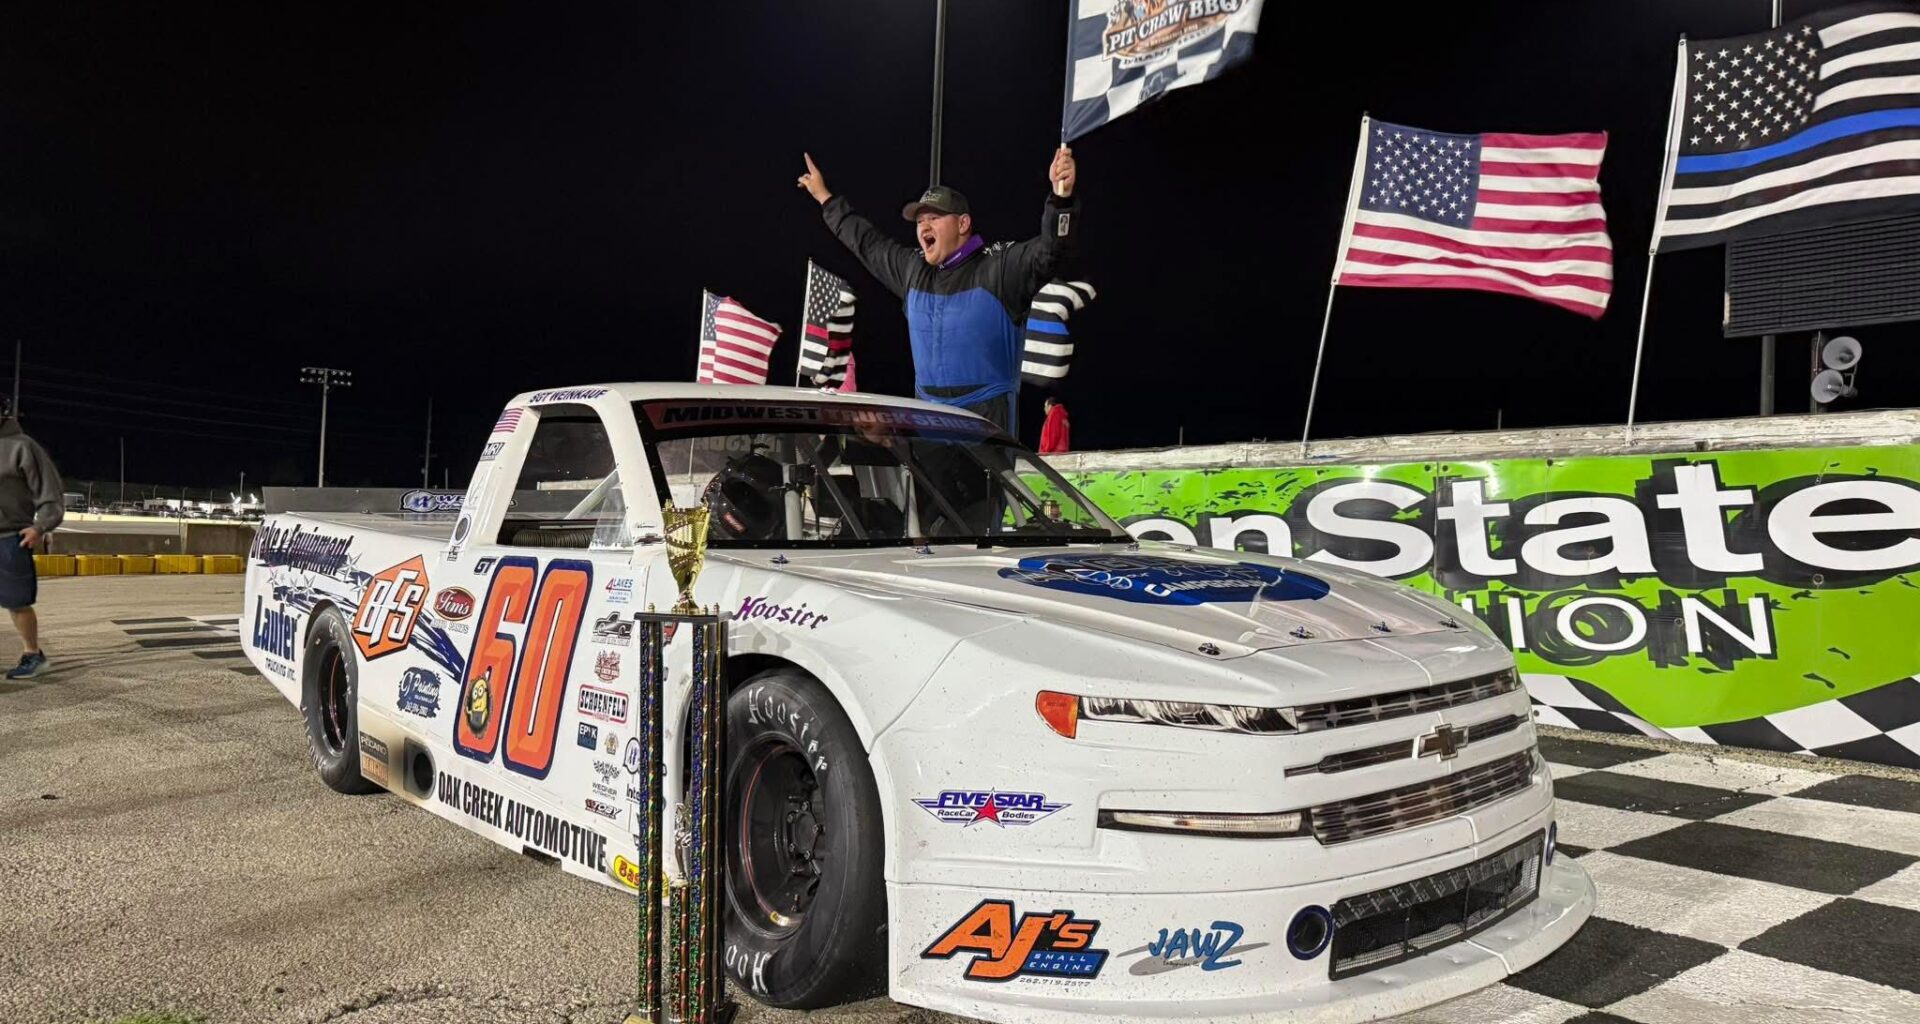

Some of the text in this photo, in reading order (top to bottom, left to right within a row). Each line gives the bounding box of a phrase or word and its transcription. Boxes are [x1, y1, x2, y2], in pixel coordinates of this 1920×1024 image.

[1109, 27, 1136, 51] PIT
[1139, 3, 1185, 38] CREW
[1188, 0, 1240, 19] BBQ
[549, 389, 608, 401] WEINKAUF
[661, 405, 819, 424] MIDWEST
[823, 408, 910, 425] TRUCK
[474, 557, 498, 575] GT
[733, 596, 829, 630] Hoosier
[452, 555, 594, 781] 60
[580, 690, 626, 718] SCHOENFELD
[937, 792, 1044, 810] FIVE STAR
[438, 771, 608, 874] OAK CREEK AUTOMOTIVE
[937, 809, 1035, 819] RaceCar Bodies
[920, 898, 1102, 981] AJ's
[1149, 920, 1244, 972] JAWZ
[1029, 961, 1093, 971] ENGINE
[1034, 953, 1086, 962] SMALL
